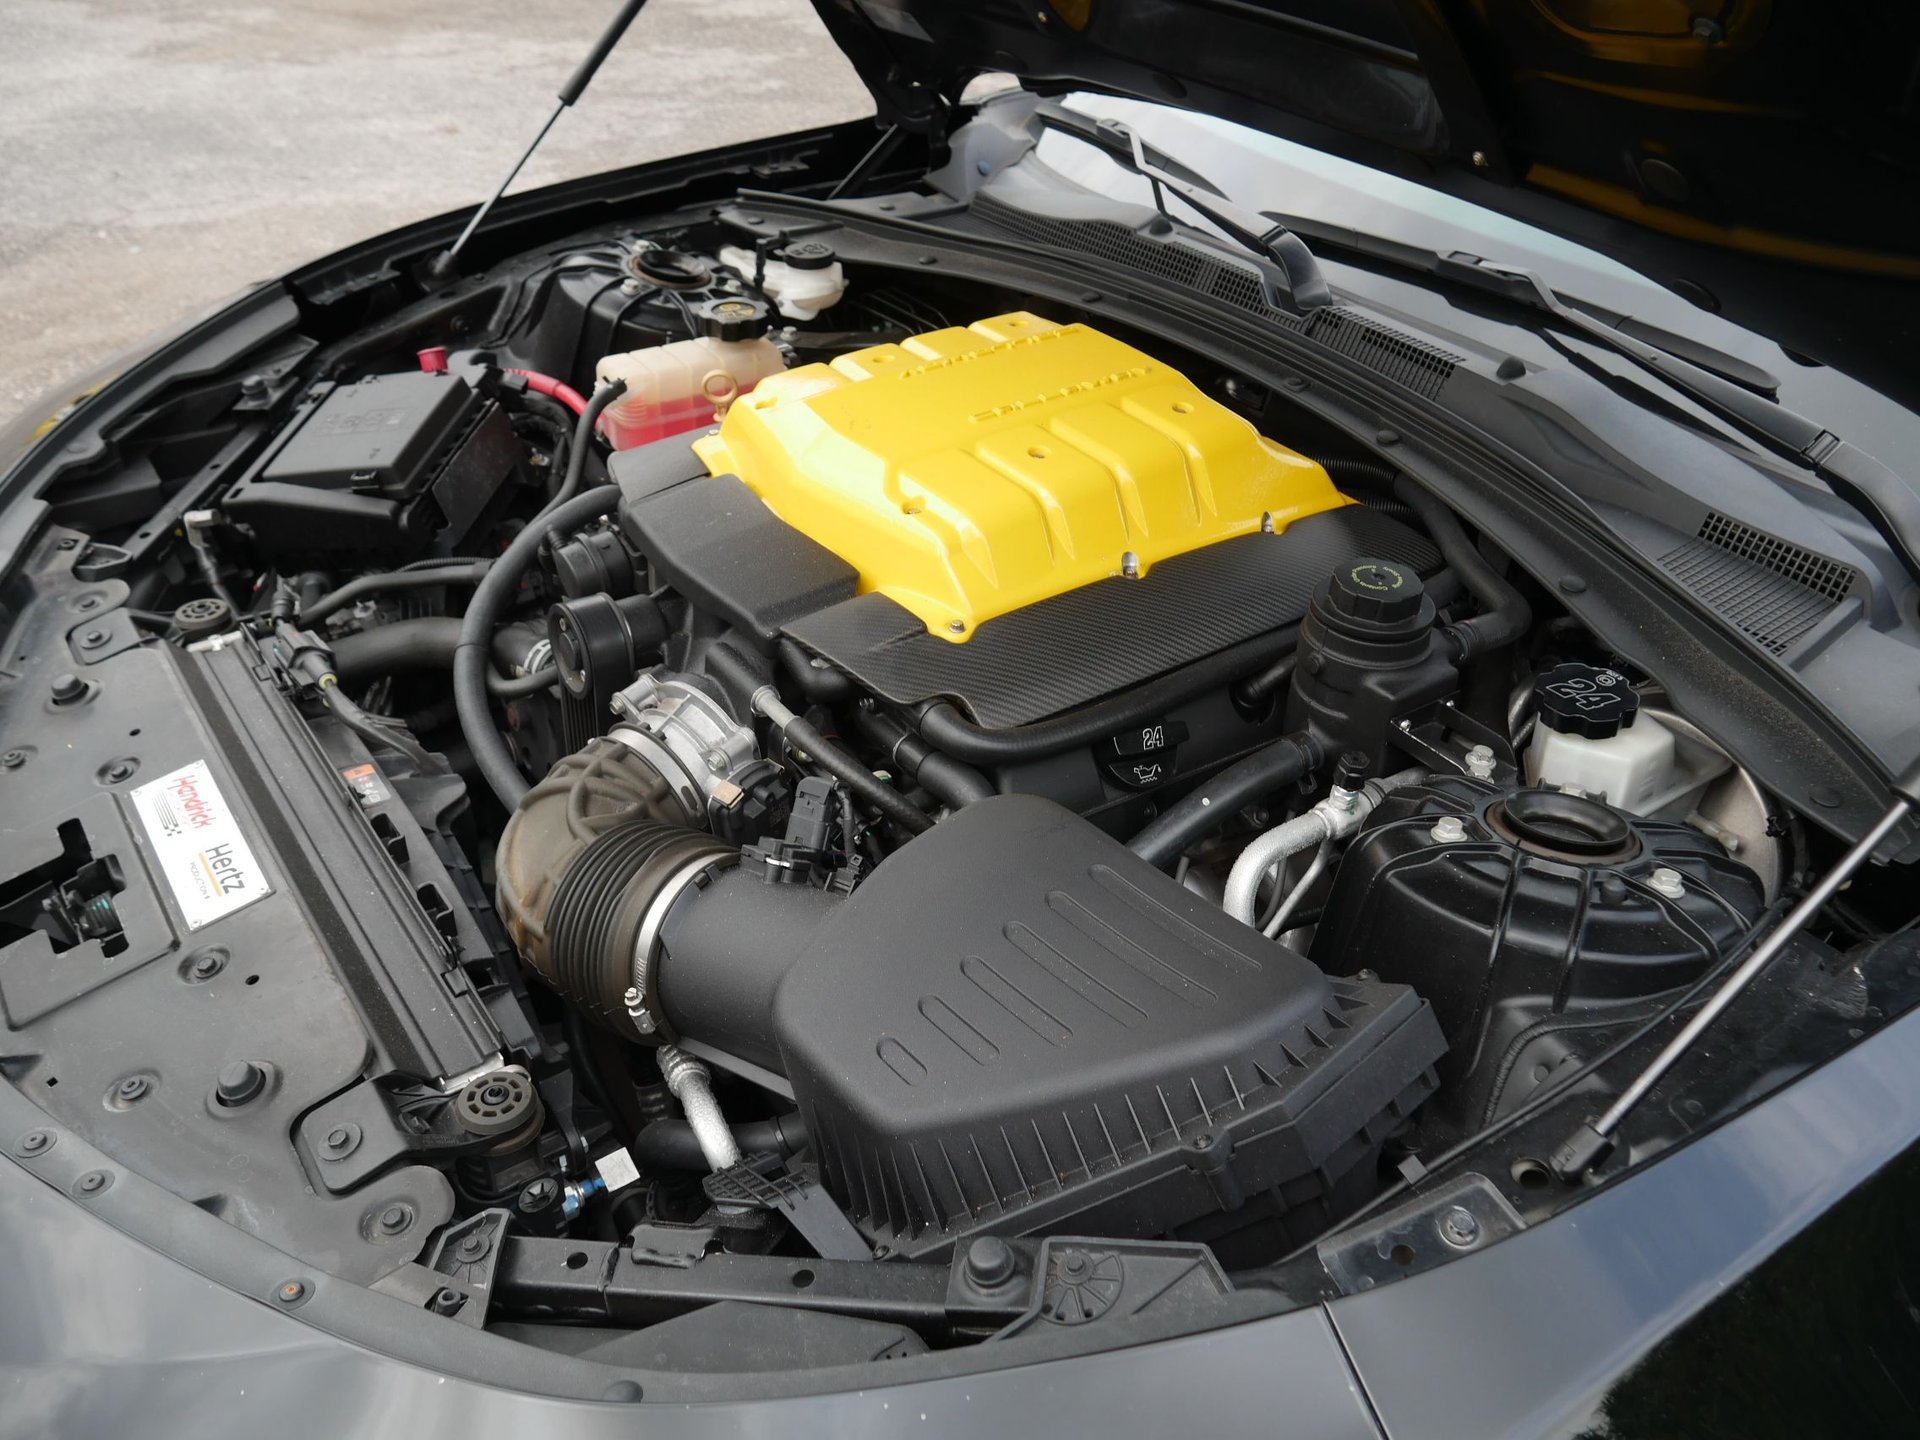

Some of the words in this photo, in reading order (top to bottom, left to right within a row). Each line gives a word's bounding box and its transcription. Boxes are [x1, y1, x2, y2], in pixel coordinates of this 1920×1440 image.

[1546, 678, 1621, 710] 24
[1143, 725, 1164, 750] 24
[167, 774, 216, 829] Hendrick
[205, 843, 245, 895] Hertz
